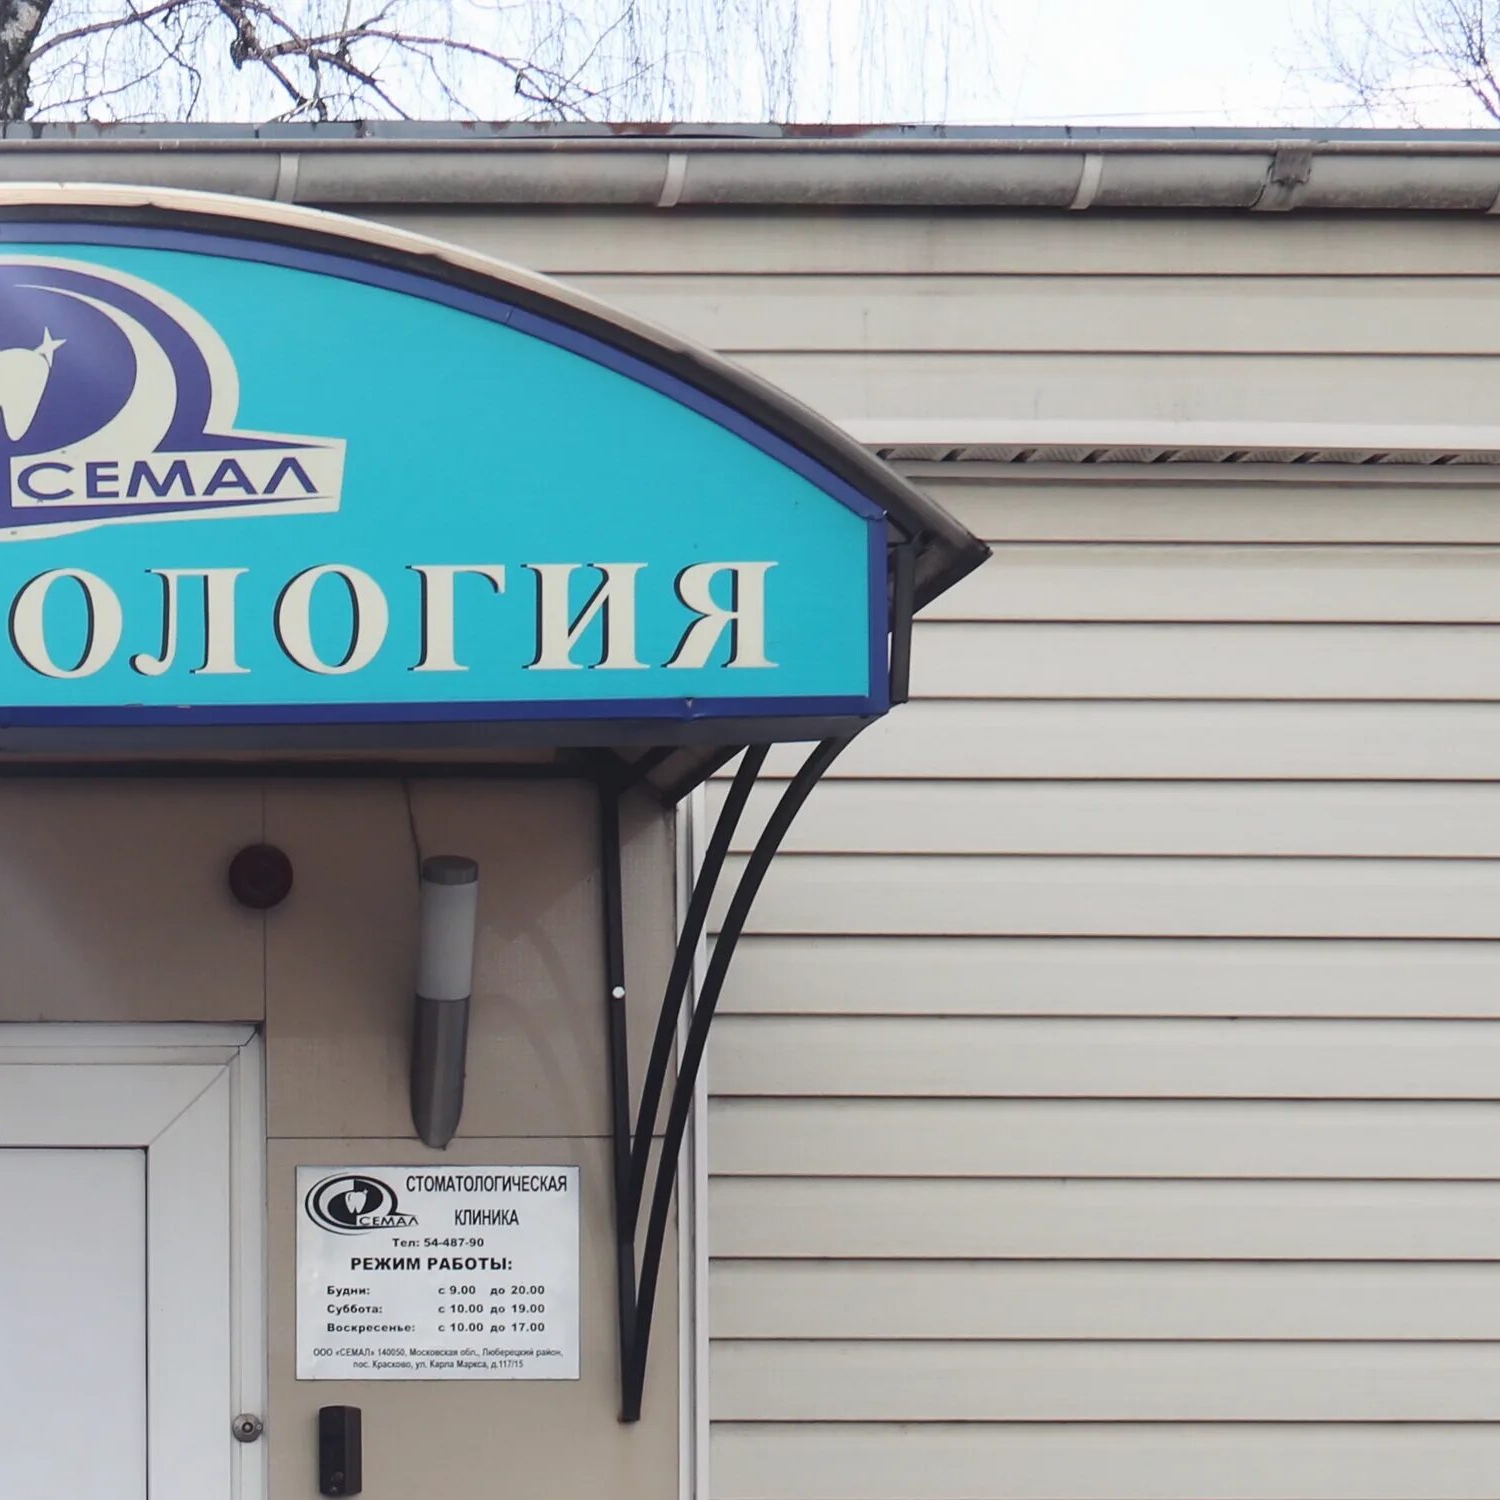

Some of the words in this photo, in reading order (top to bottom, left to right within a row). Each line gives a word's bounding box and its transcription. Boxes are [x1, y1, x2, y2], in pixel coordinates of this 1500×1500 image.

[17, 457, 318, 500] СЕМАЛ
[406, 1175, 567, 1192] СТОМАТОЛОГИЧЕСКАЯ
[360, 1214, 419, 1226] СЕМАЛ
[455, 1209, 519, 1225] КЛИНИКА
[392, 1238, 419, 1247] Тел:
[424, 1238, 484, 1247] 54-487-90
[351, 1258, 420, 1270] РЕЖИМ
[428, 1257, 512, 1270] РАБОТЫ:
[327, 1286, 369, 1297] Будни:
[450, 1285, 475, 1294] 9.00
[511, 1285, 544, 1294] 20.00
[327, 1304, 382, 1315] Суббота:
[451, 1304, 483, 1313] 10.00
[490, 1306, 505, 1314] до
[512, 1304, 544, 1313] 19.00
[327, 1323, 414, 1334] Воскресенье:
[451, 1323, 483, 1332] 10.00
[490, 1325, 505, 1333] до
[512, 1323, 544, 1332] 17.00
[313, 1348, 333, 1356] ООО
[336, 1348, 374, 1356] «СЕМАЛ»
[378, 1348, 407, 1358] 140050,
[410, 1348, 458, 1356] Московская
[482, 1348, 534, 1358] Люберецкий
[373, 1360, 413, 1369] Красково,
[416, 1362, 427, 1370] ул.
[430, 1360, 454, 1369] Карла
[457, 1360, 488, 1369] Маркса,
[491, 1360, 523, 1369] д.117/15
